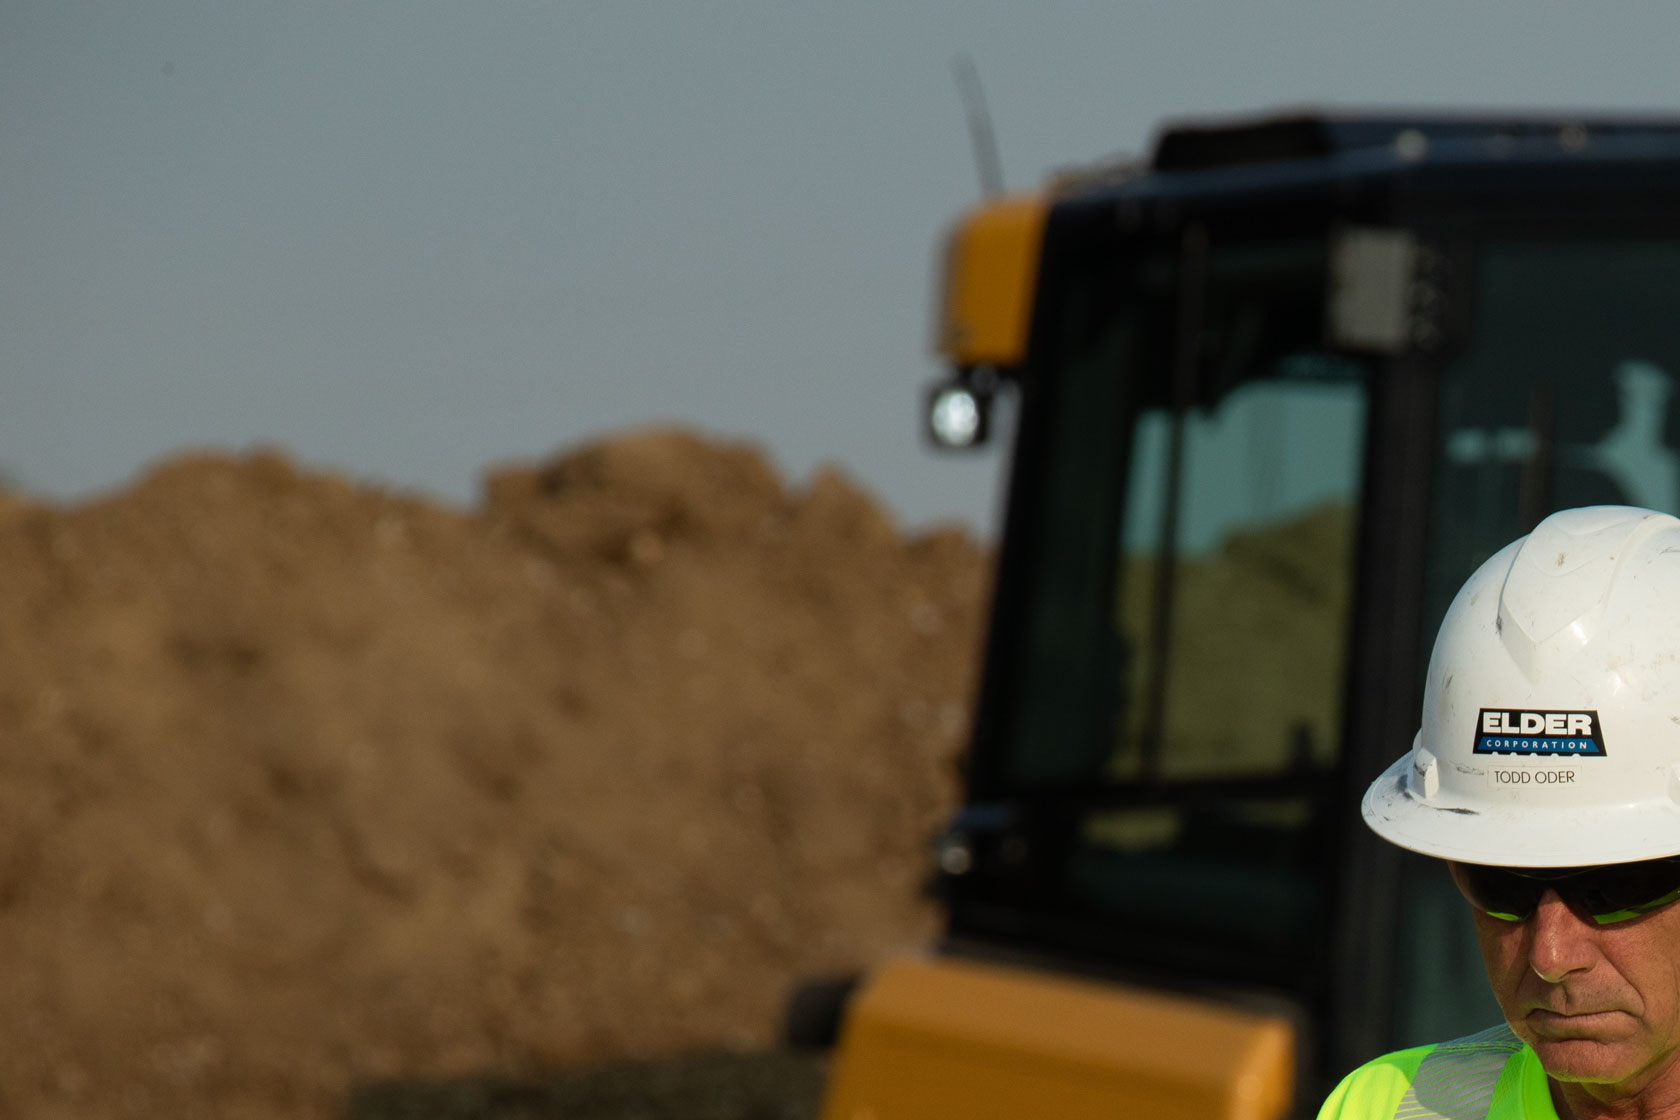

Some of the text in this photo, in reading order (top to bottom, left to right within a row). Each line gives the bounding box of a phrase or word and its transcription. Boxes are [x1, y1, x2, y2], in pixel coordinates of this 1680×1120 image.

[1482, 711, 1592, 736] ELDER
[1486, 739, 1587, 749] CORPORATION
[1494, 770, 1575, 784] TODD ODER
